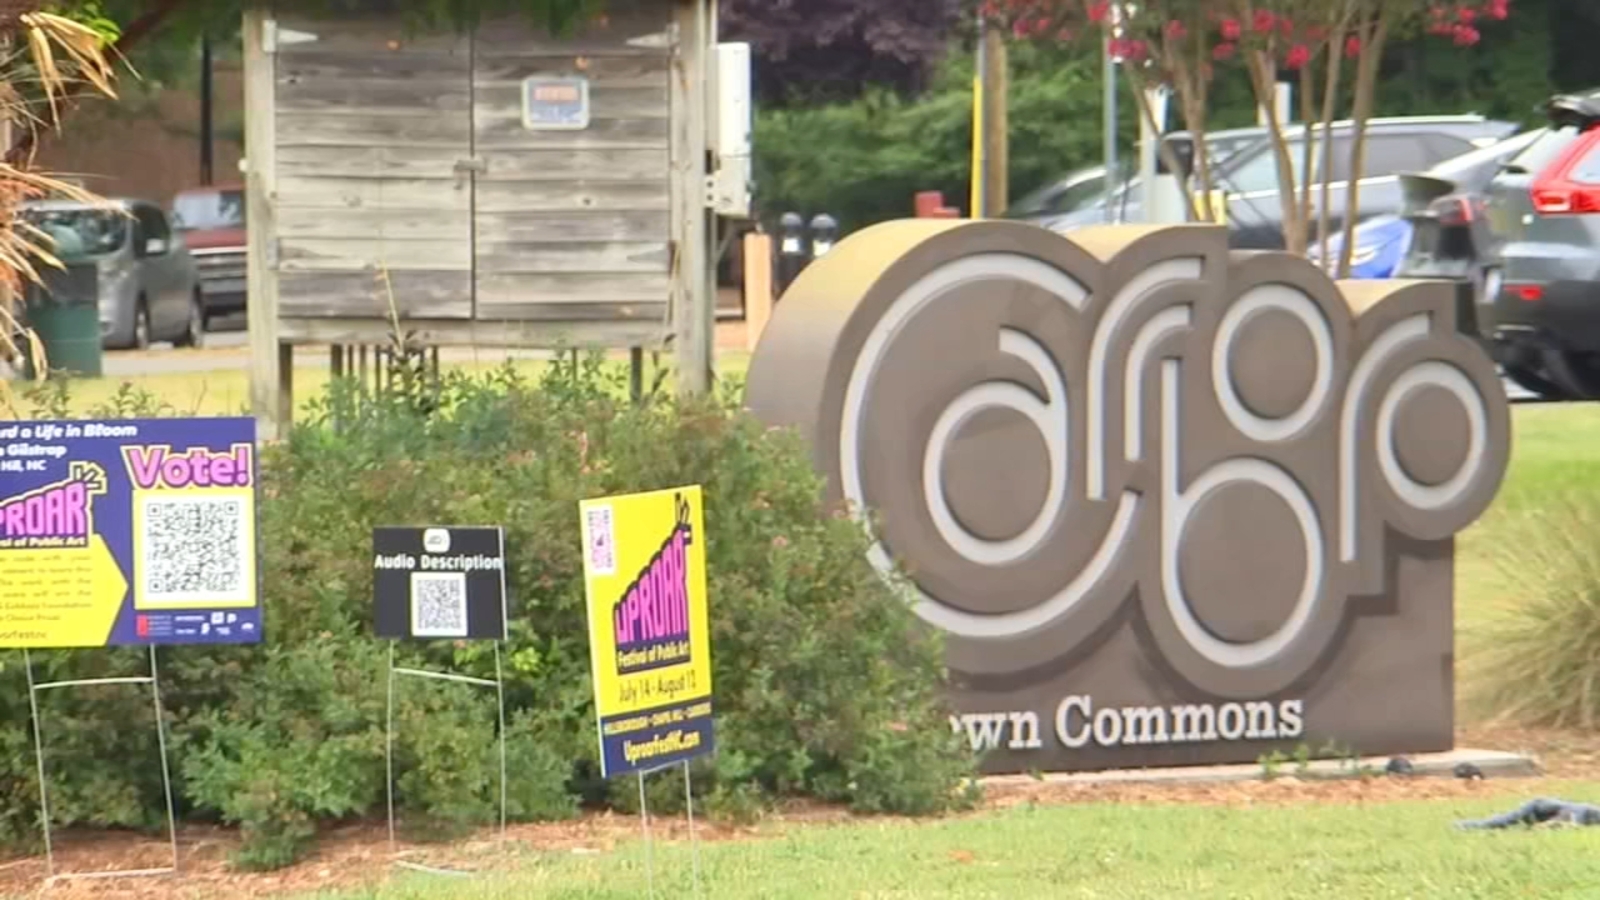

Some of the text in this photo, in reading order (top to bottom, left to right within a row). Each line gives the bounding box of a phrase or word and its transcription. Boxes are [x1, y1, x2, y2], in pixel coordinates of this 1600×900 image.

[21, 428, 32, 438] a
[35, 424, 63, 440] Life
[65, 424, 81, 438] in
[84, 423, 138, 437] Bloom
[1, 460, 47, 472] Hill, NC
[125, 445, 252, 489] Vote!
[14, 537, 27, 547] of
[29, 537, 65, 546] Public
[66, 536, 86, 546] Art
[374, 553, 502, 572] Audio Description
[615, 528, 688, 645] UPROAR
[618, 646, 647, 668] Festival
[648, 644, 656, 663] of
[657, 641, 679, 661] Public
[619, 680, 637, 704] July
[639, 678, 651, 698] 14
[657, 674, 685, 698] August
[1056, 694, 1304, 748] Commons
